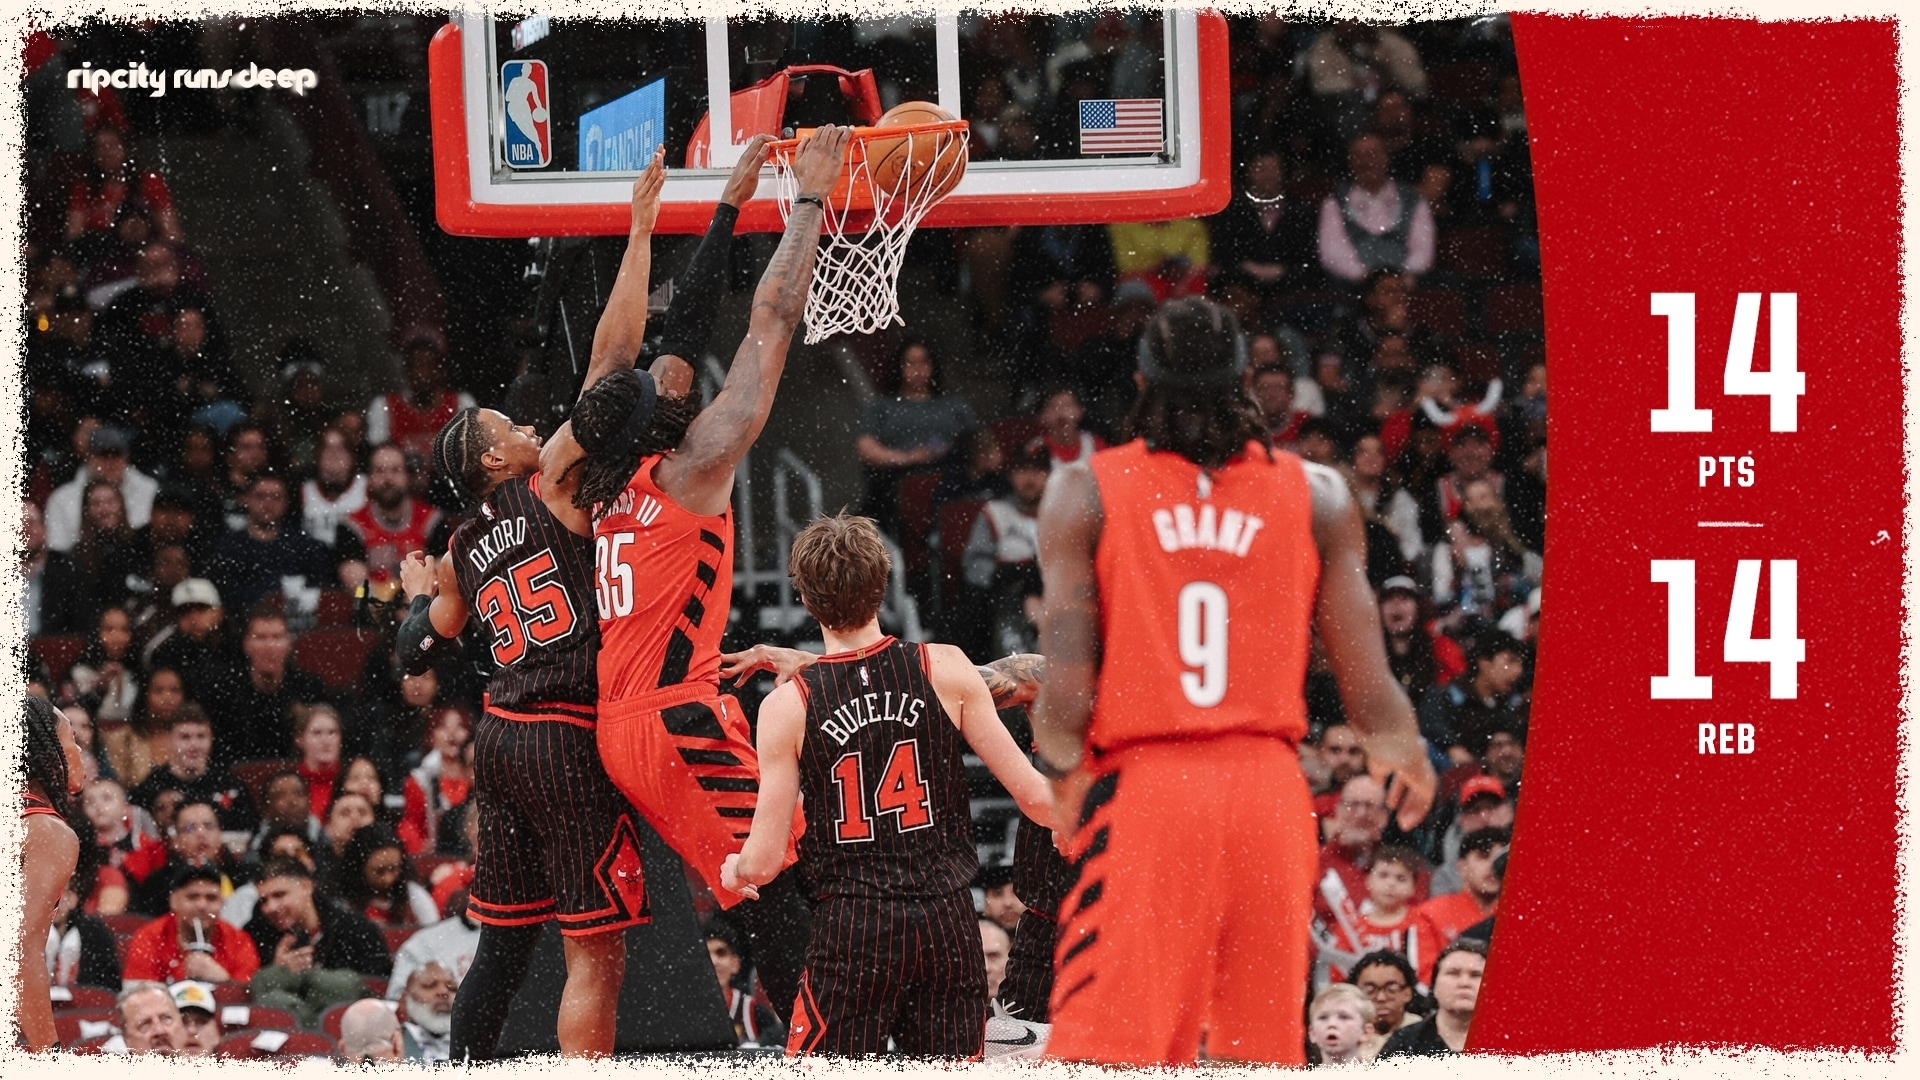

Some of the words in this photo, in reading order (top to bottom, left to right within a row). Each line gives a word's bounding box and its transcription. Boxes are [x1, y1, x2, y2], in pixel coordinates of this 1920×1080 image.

[511, 143, 534, 161] NBA
[469, 517, 526, 573] OKORO
[1152, 503, 1264, 557] GRANT
[476, 548, 578, 667] 35
[595, 532, 635, 620] 35
[1178, 580, 1229, 708] 9
[820, 691, 925, 746] BUZELIS
[831, 738, 934, 844] 14
